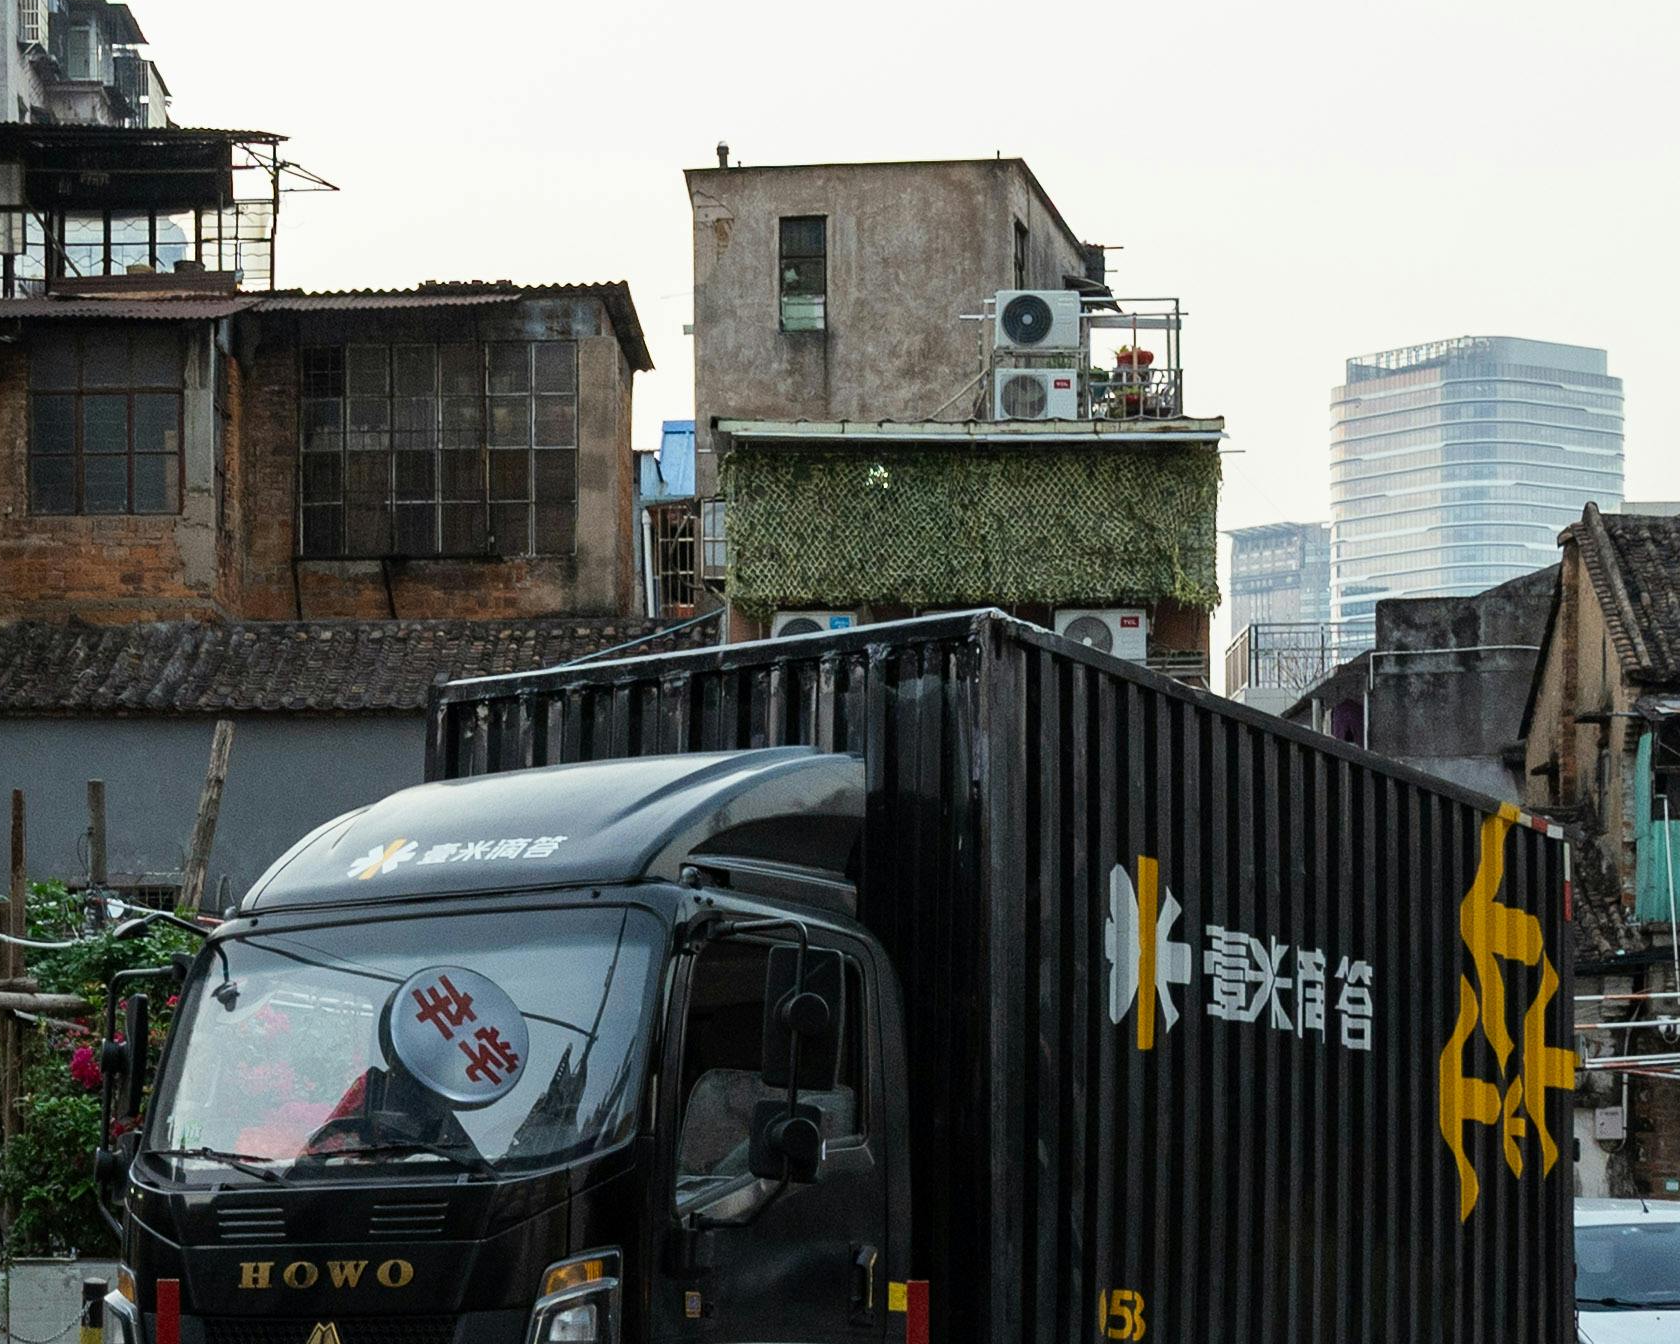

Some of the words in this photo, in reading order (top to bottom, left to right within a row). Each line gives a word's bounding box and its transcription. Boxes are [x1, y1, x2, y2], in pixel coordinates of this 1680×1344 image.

[416, 835, 569, 866] 壹米滴答
[238, 1260, 414, 1288] HOWO
